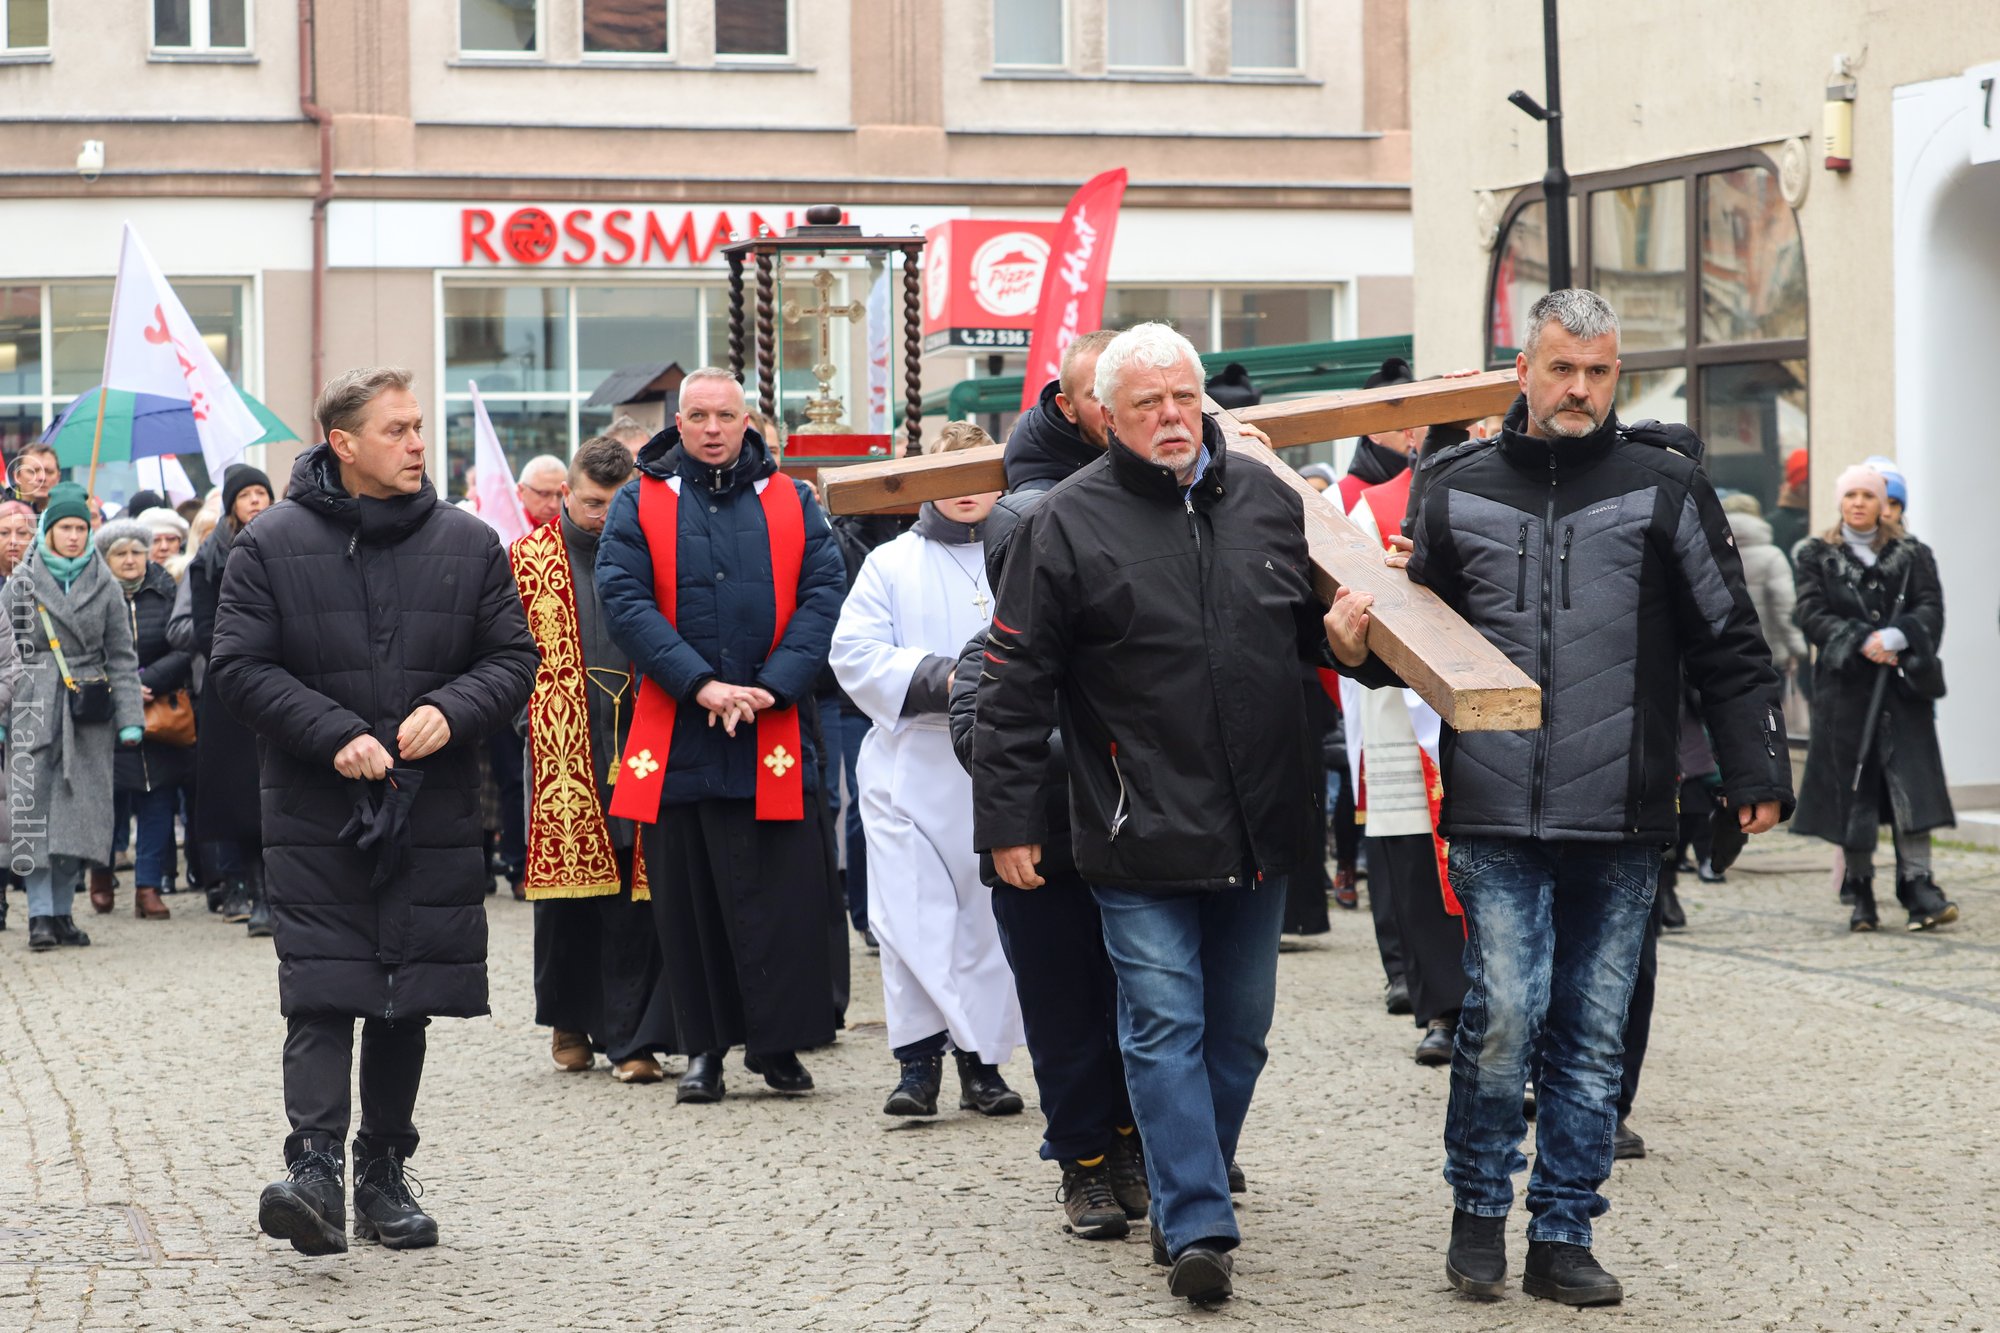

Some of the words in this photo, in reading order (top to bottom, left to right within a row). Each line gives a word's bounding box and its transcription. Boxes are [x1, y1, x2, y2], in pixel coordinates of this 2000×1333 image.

[988, 267, 1036, 288] Pizza
[997, 282, 1033, 301] Hut
[976, 329, 995, 345] 22
[997, 329, 1026, 345] 536
